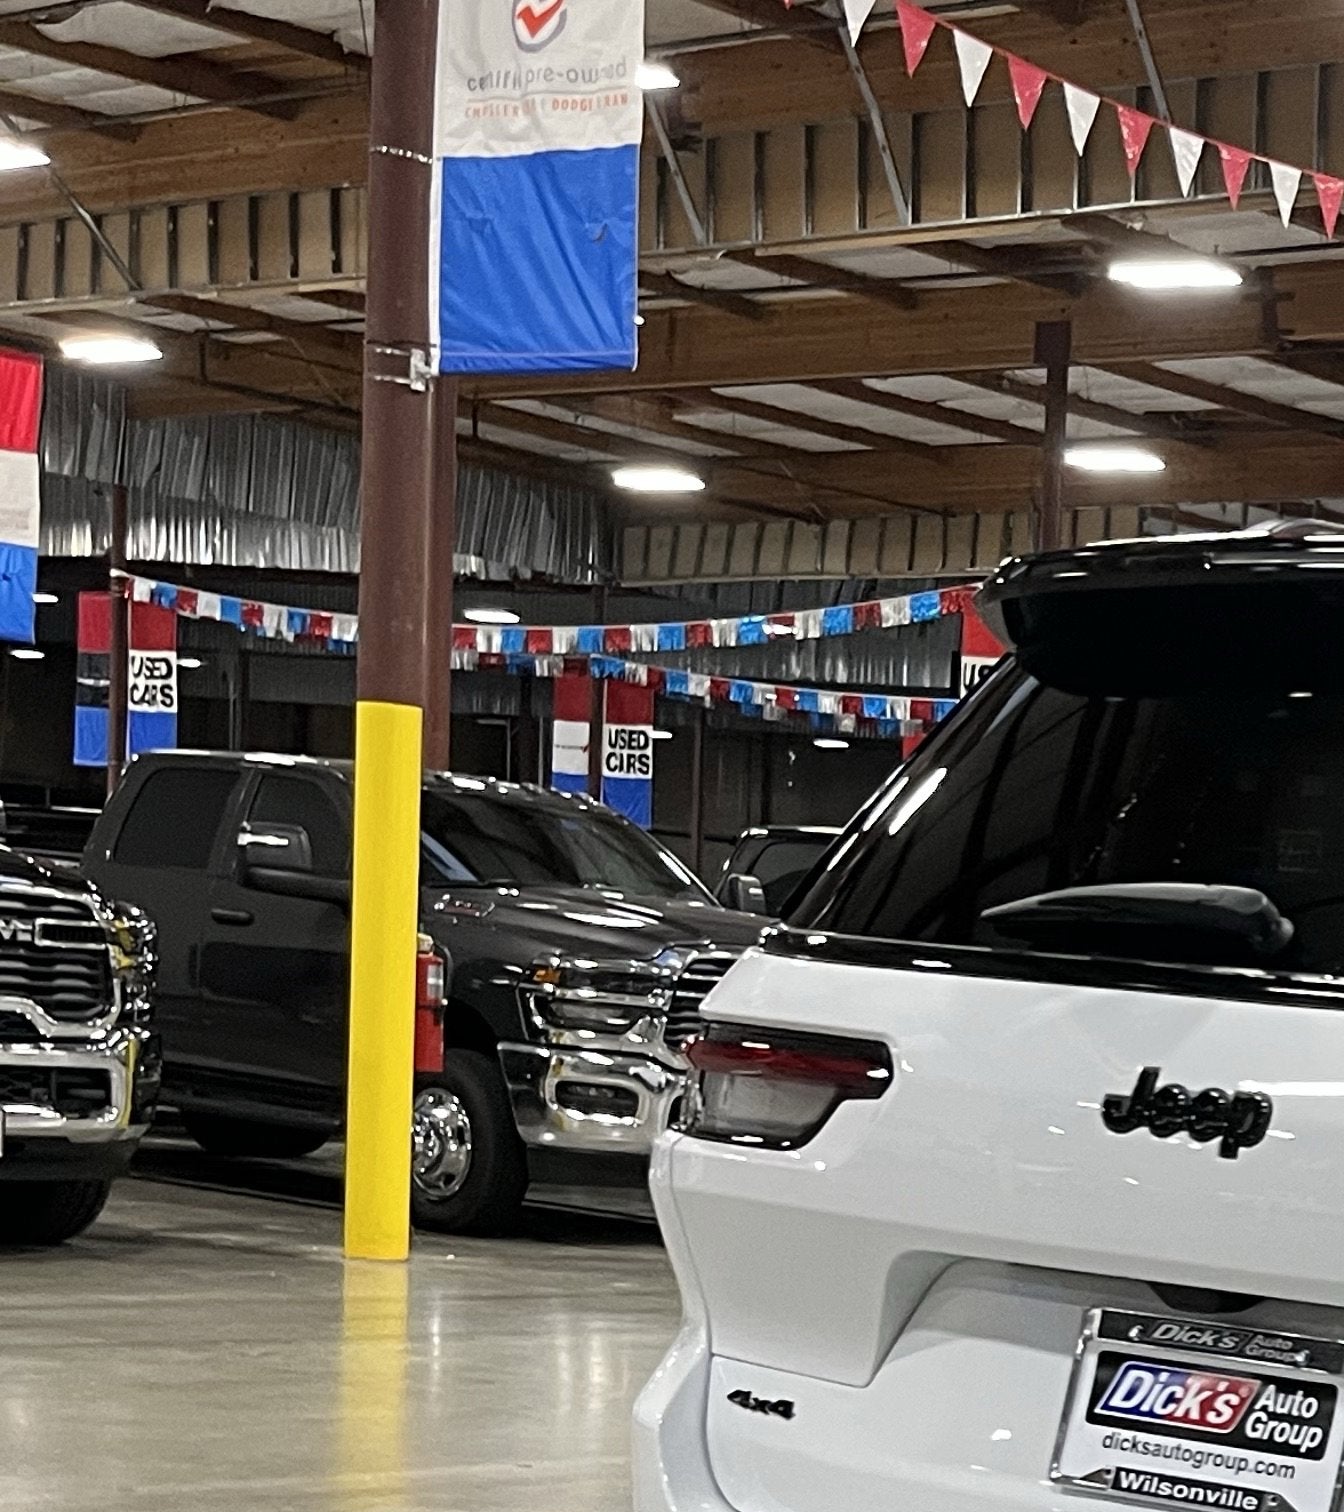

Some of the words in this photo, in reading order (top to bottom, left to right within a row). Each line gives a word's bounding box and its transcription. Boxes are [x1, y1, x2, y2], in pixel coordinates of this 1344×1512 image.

[131, 655, 173, 679] USED
[129, 683, 174, 708] CARS
[607, 728, 650, 750] USED
[1102, 1066, 1273, 1159] Jeep
[1153, 1322, 1241, 1350] Dick's
[1252, 1333, 1294, 1350] Auto
[727, 1389, 797, 1421] 4x4
[1108, 1369, 1241, 1425] Dick's
[1254, 1384, 1319, 1419] Auto
[1244, 1411, 1323, 1453] Group
[1102, 1432, 1296, 1479] dicksautogroup.com
[1118, 1470, 1260, 1511] Wilsonville
